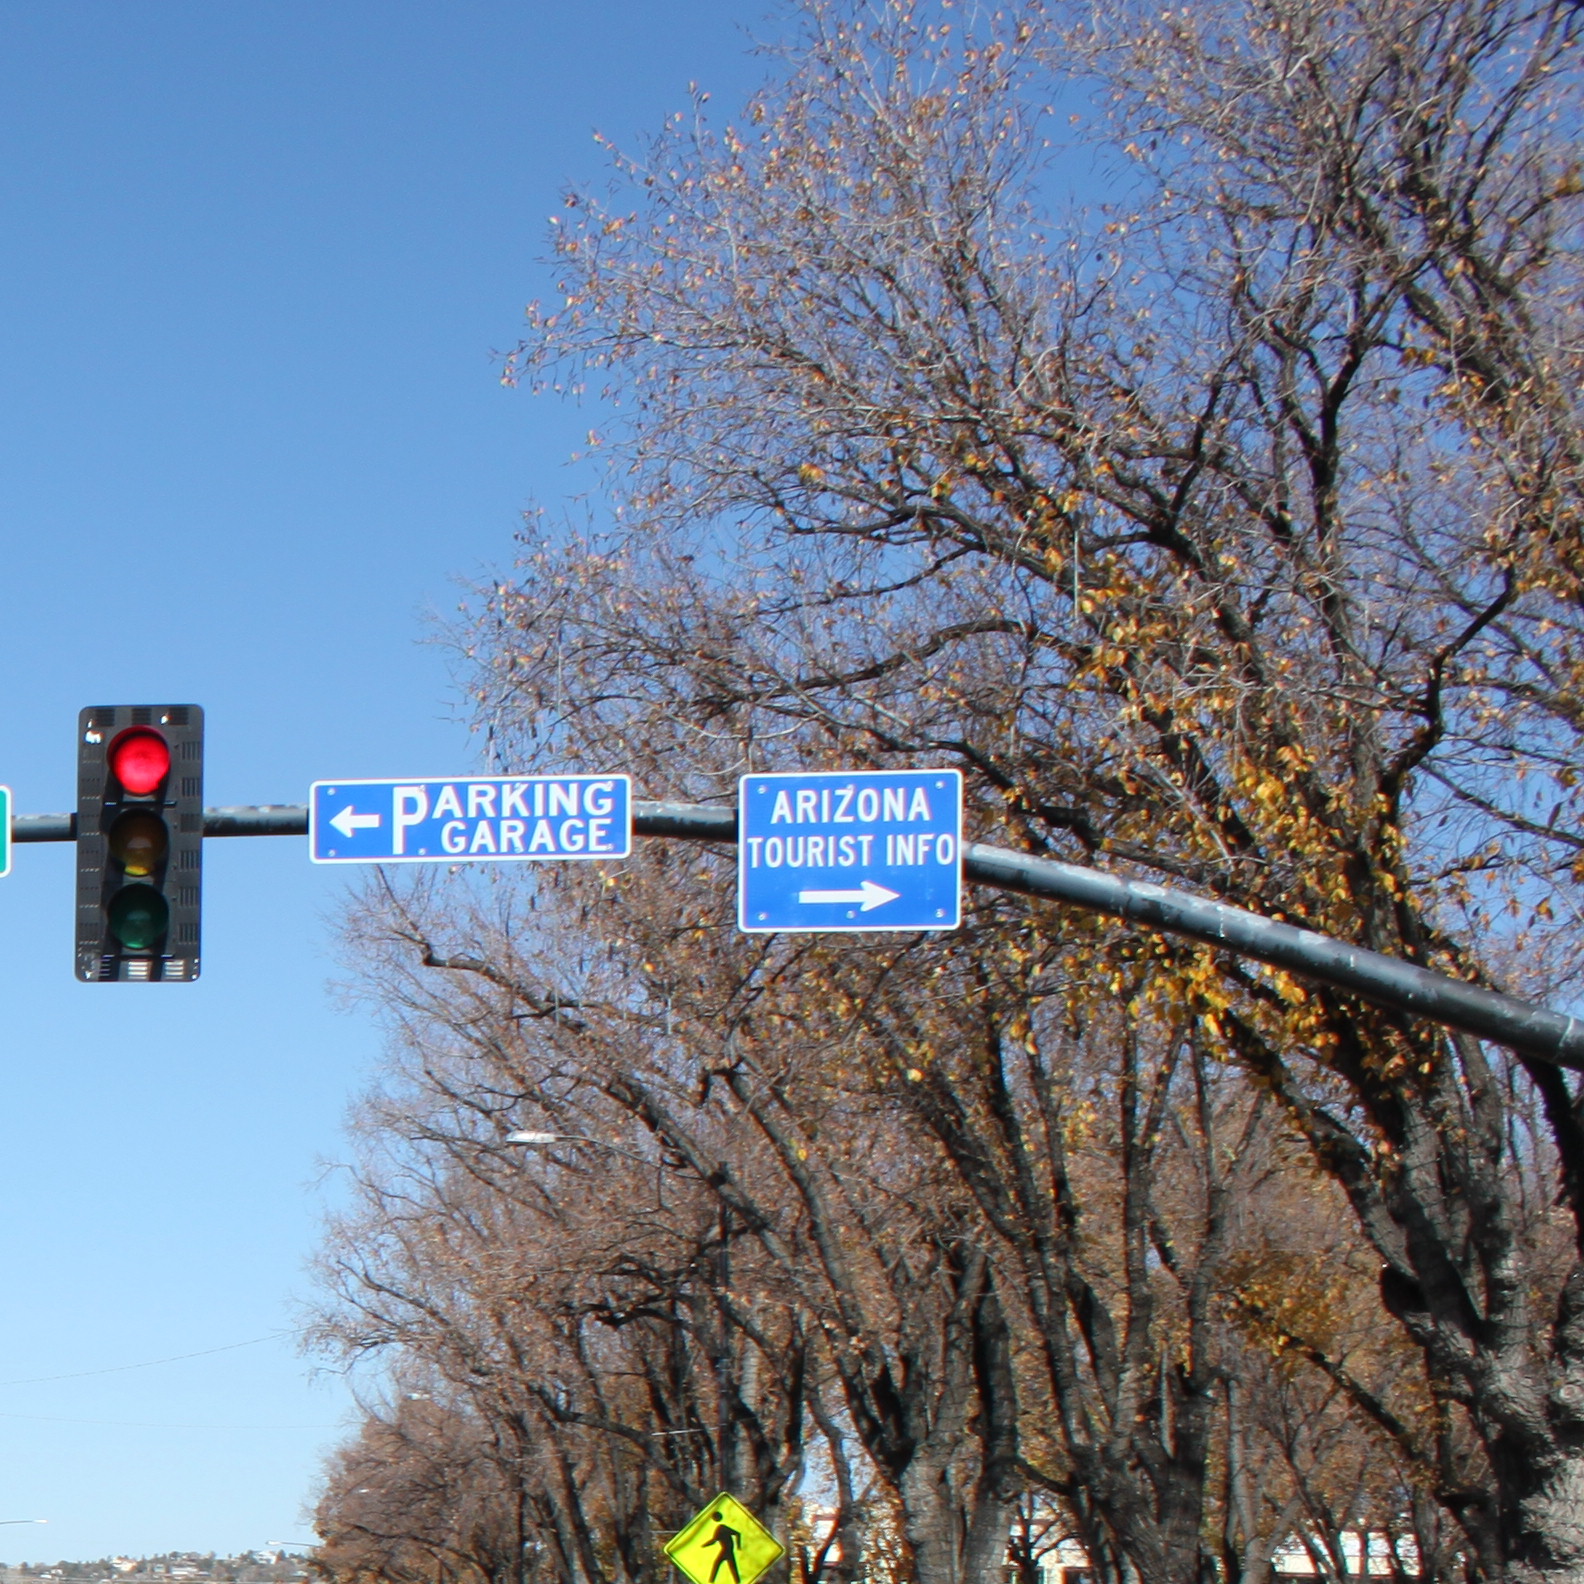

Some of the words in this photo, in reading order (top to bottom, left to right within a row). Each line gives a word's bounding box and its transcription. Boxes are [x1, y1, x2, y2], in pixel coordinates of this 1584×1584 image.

[392, 783, 613, 855] PARKING
[770, 787, 930, 825] ARIZONA
[440, 820, 610, 855] GARAGE
[748, 835, 875, 869] TOURIST
[886, 834, 954, 867] INFO
